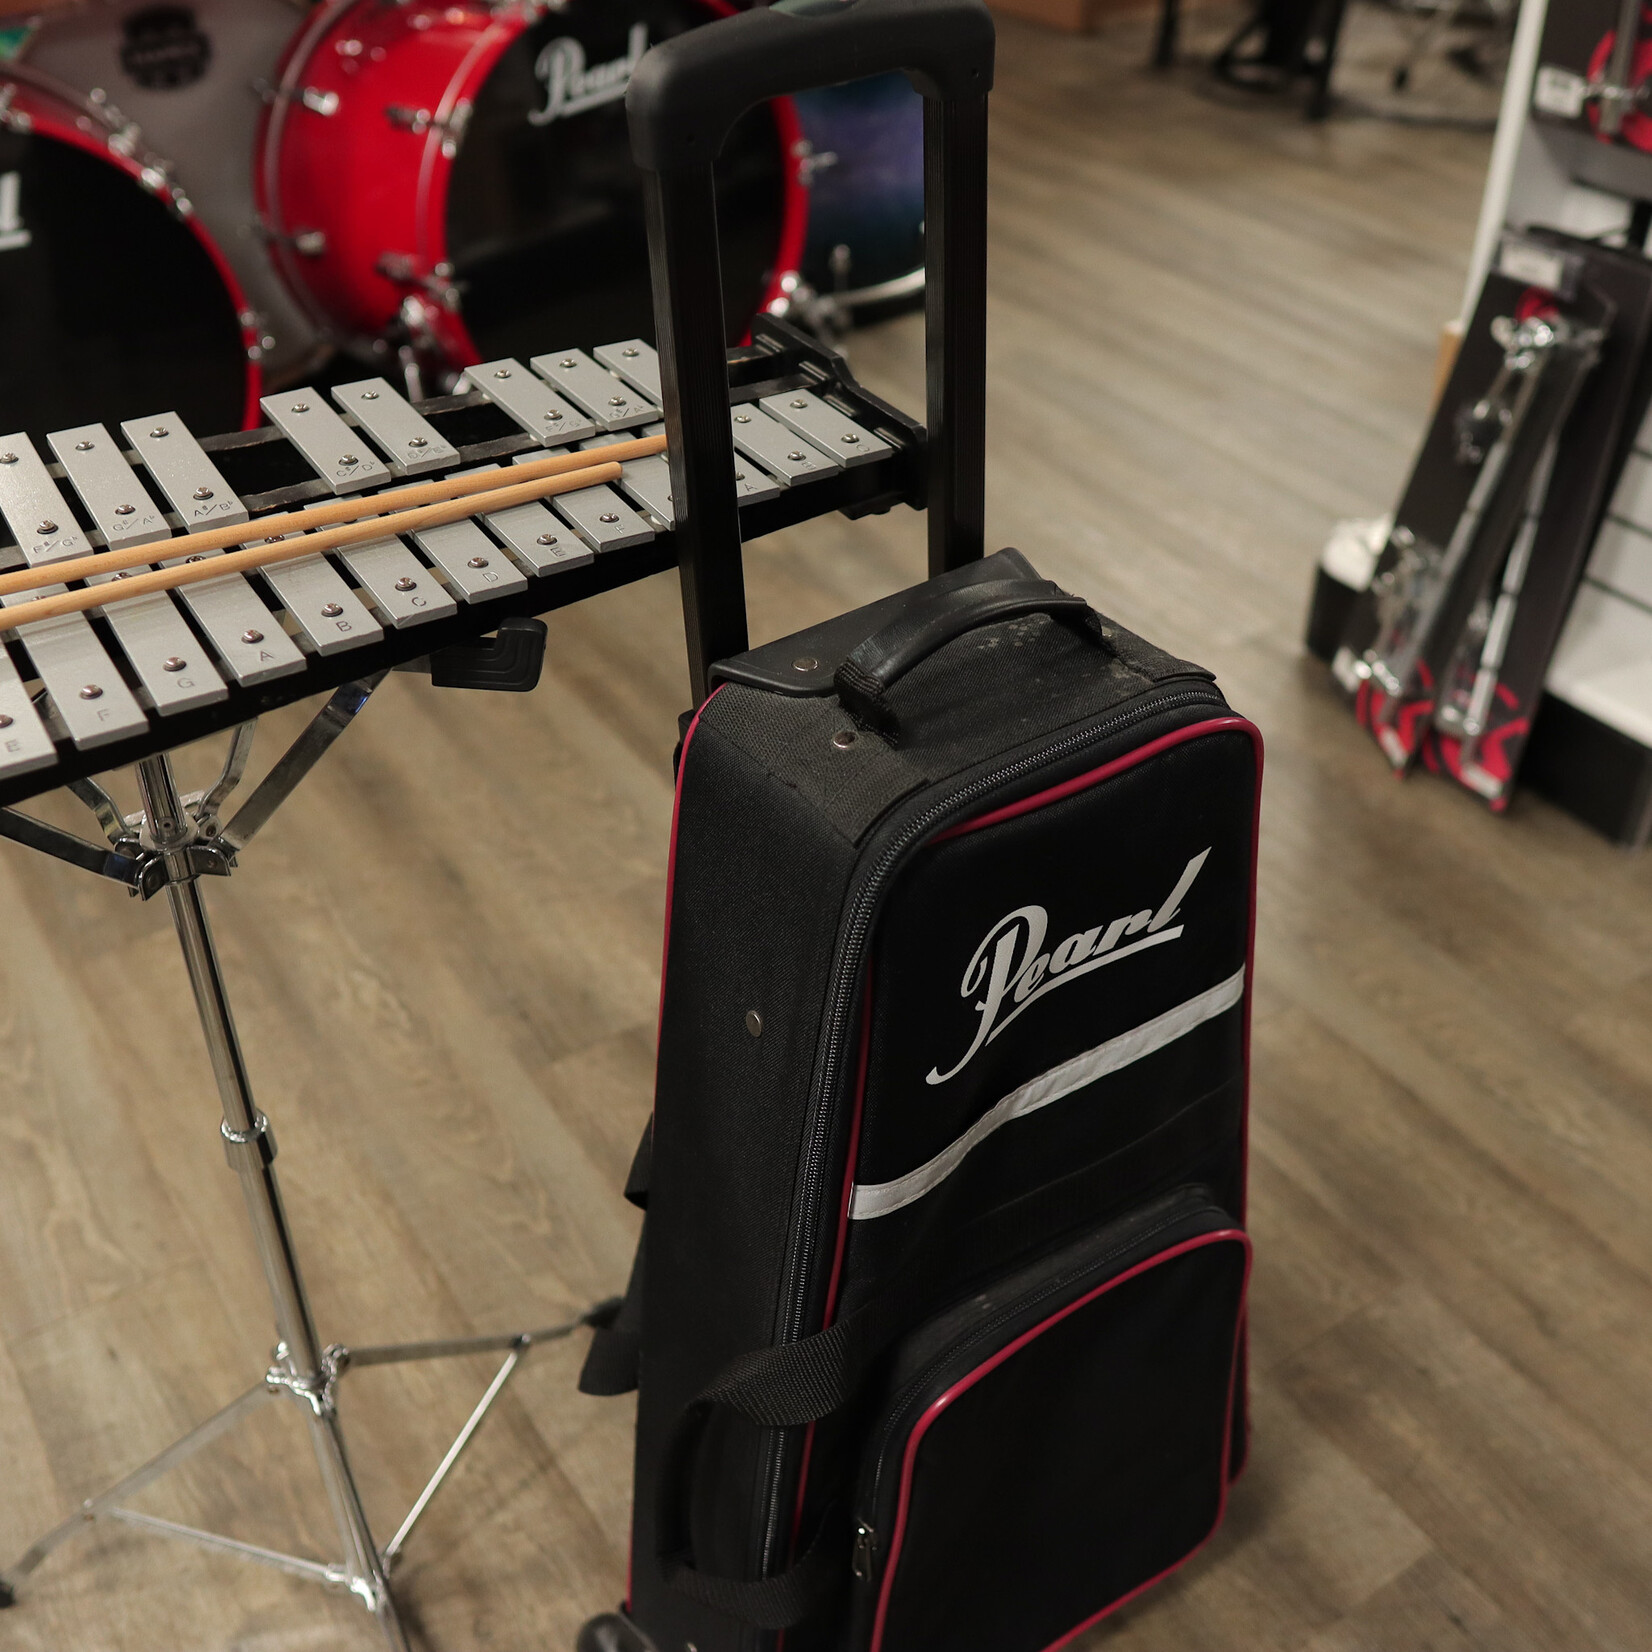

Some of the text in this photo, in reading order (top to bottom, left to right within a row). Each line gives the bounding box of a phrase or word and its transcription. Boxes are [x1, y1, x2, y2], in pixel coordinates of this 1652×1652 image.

[744, 482, 757, 492] A
[482, 571, 499, 583] D
[411, 596, 427, 607] C
[335, 621, 352, 632] B
[259, 650, 274, 662] A
[177, 677, 195, 689] G
[96, 708, 110, 722] F
[4, 738, 21, 752] E
[926, 846, 1212, 1085] Pearl
